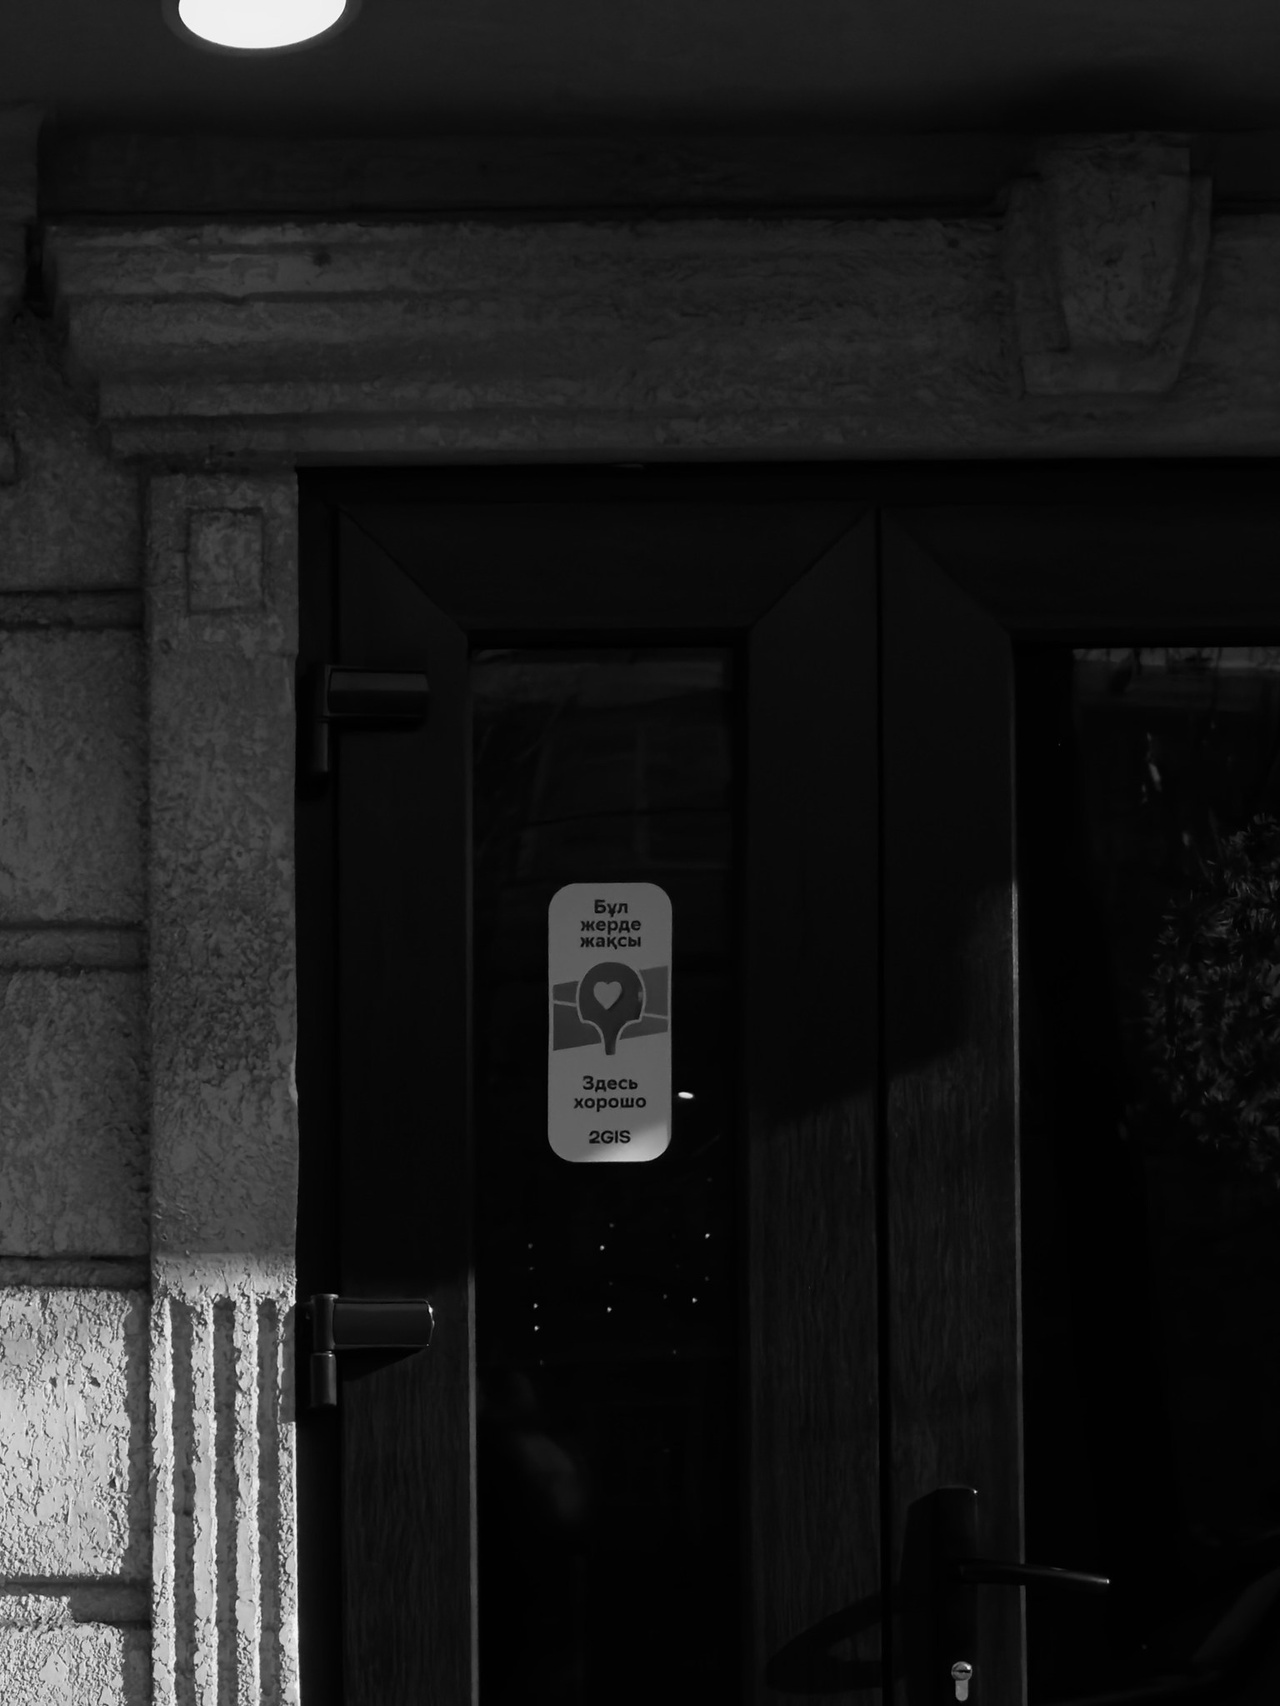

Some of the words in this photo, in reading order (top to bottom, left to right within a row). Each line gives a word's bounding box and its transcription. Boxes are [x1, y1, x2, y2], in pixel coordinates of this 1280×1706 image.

[594, 899, 628, 917] Бұл
[580, 920, 641, 934] жерде
[580, 936, 641, 949] жақсы
[582, 1076, 638, 1092] Здесь
[574, 1097, 646, 1111] хорошо
[588, 1131, 631, 1144] 2GIS
